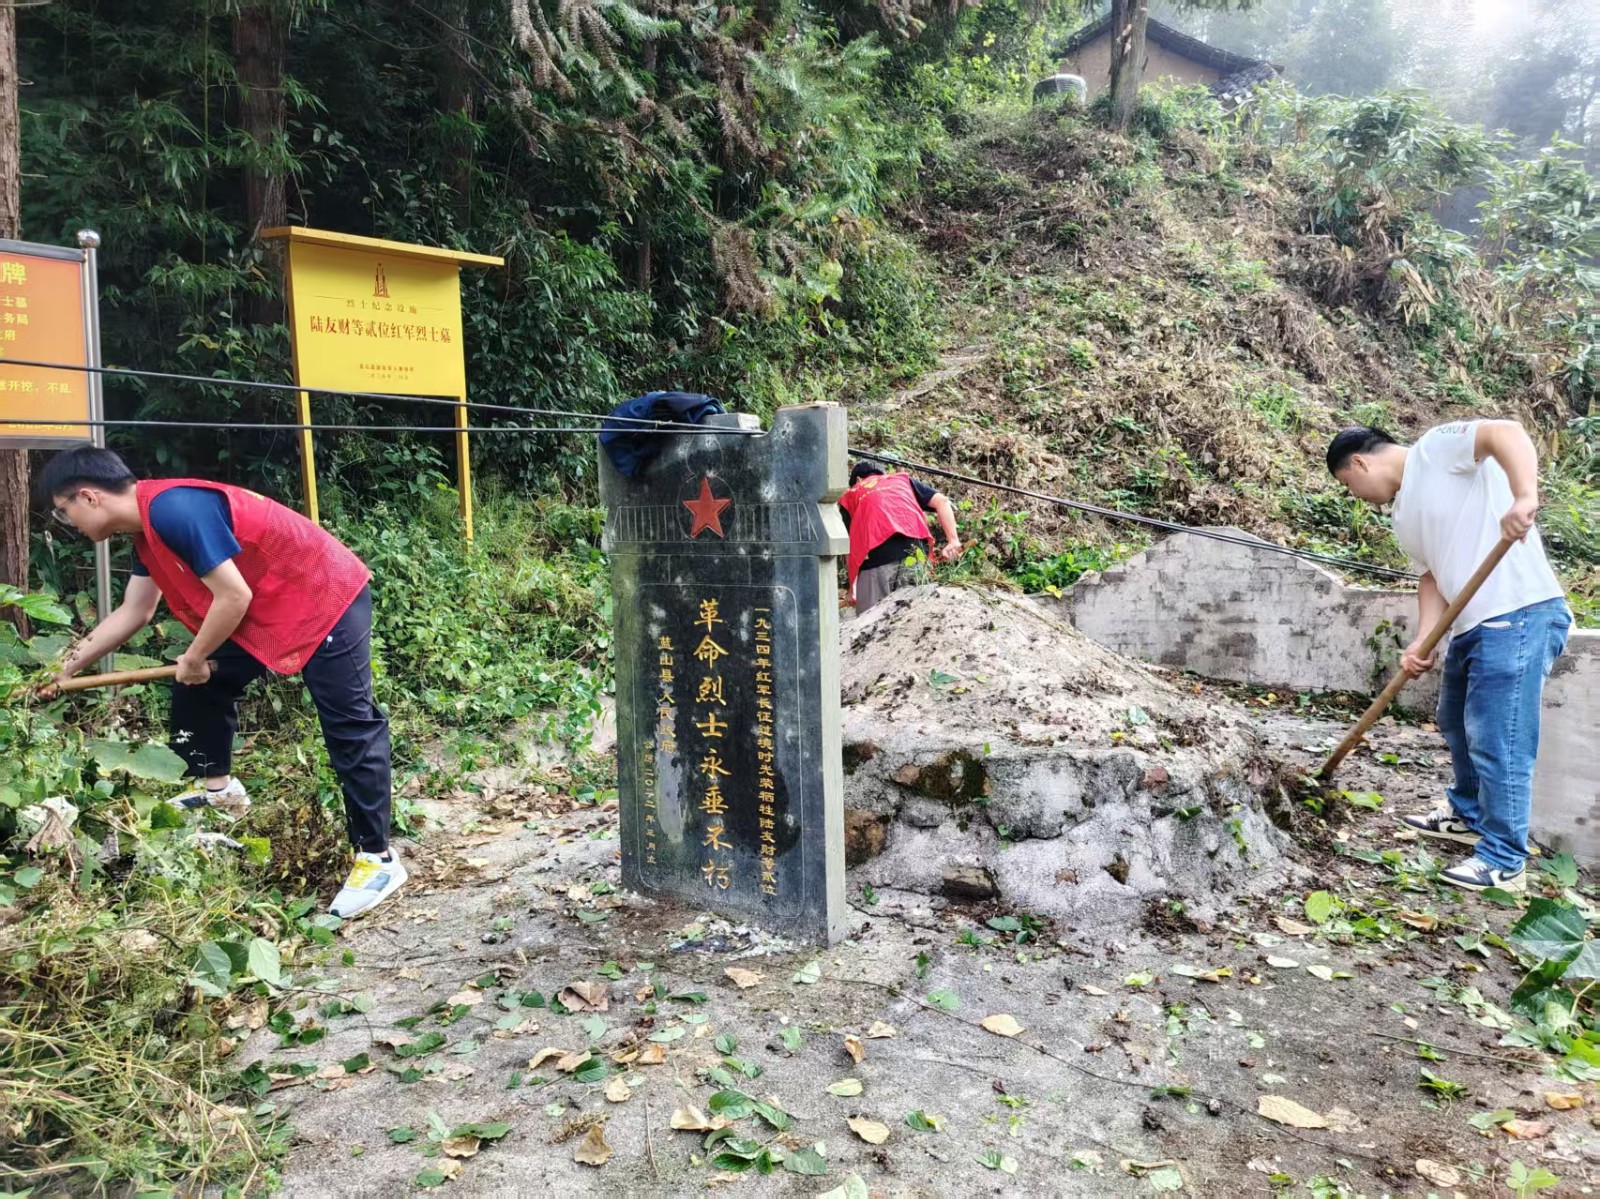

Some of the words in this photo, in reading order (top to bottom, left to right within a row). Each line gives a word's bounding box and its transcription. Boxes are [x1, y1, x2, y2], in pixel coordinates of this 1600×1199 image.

[1, 261, 27, 285] 牌
[346, 299, 418, 314] 烈士纪念设施
[310, 315, 452, 344] 陆友财等贰位红军烈士墓
[657, 636, 676, 754] 蓝山县人民政府
[693, 599, 733, 889] 革命烈士永垂不朽
